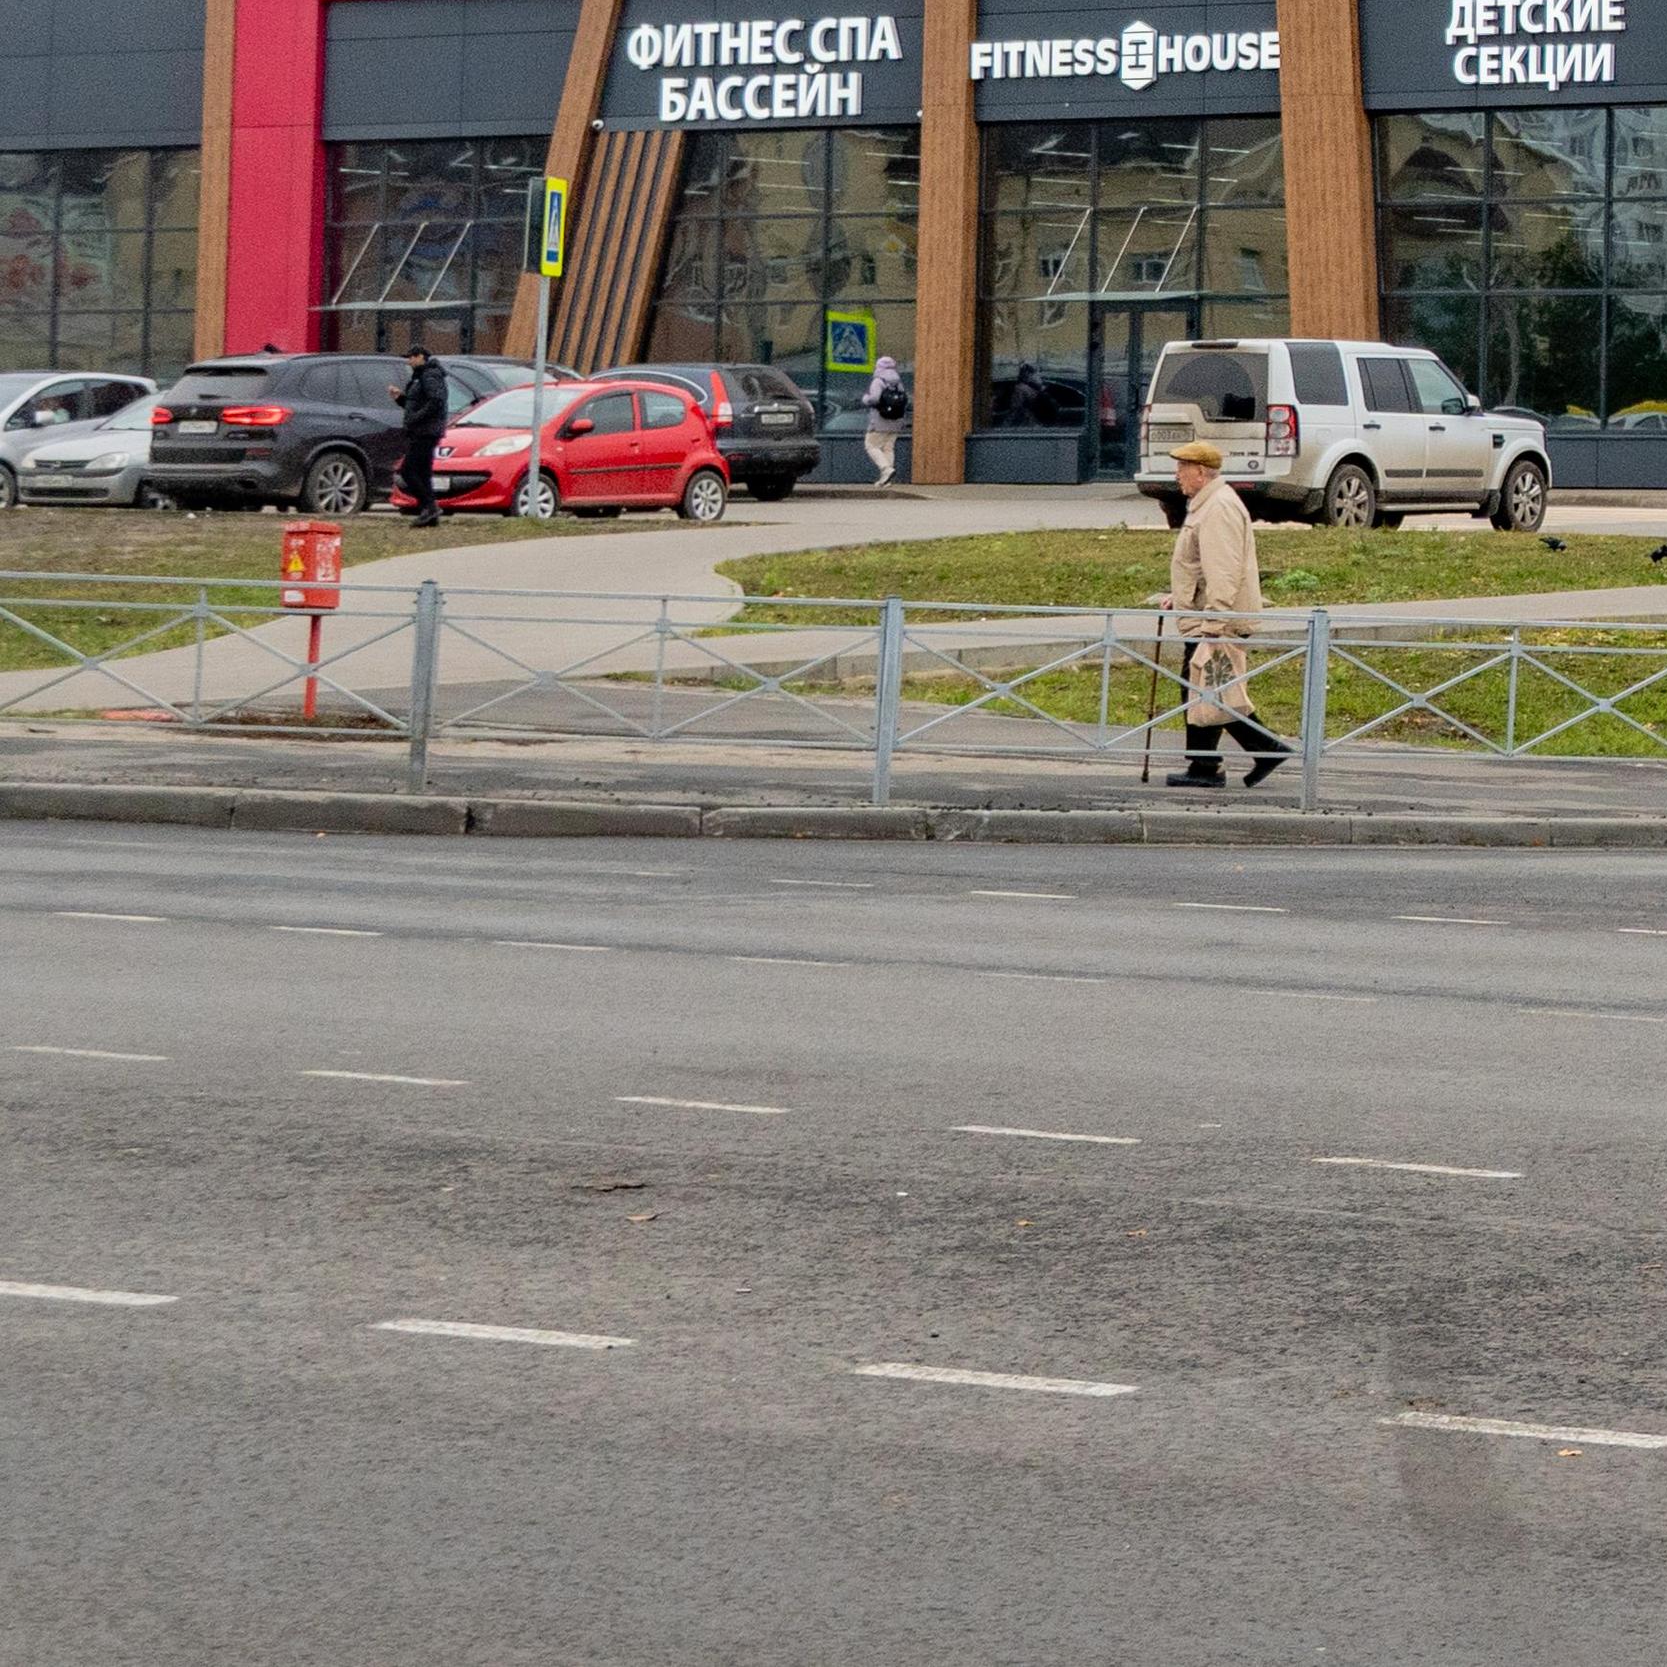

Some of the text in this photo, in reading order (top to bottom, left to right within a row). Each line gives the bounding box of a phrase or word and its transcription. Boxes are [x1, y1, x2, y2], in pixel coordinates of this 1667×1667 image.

[627, 16, 902, 70] ФИТНЕС СПА
[970, 31, 1280, 79] FITNESS HOUSE
[1453, 43, 1616, 91] СЕКЦИИ
[660, 63, 863, 122] БАССЕЙН
